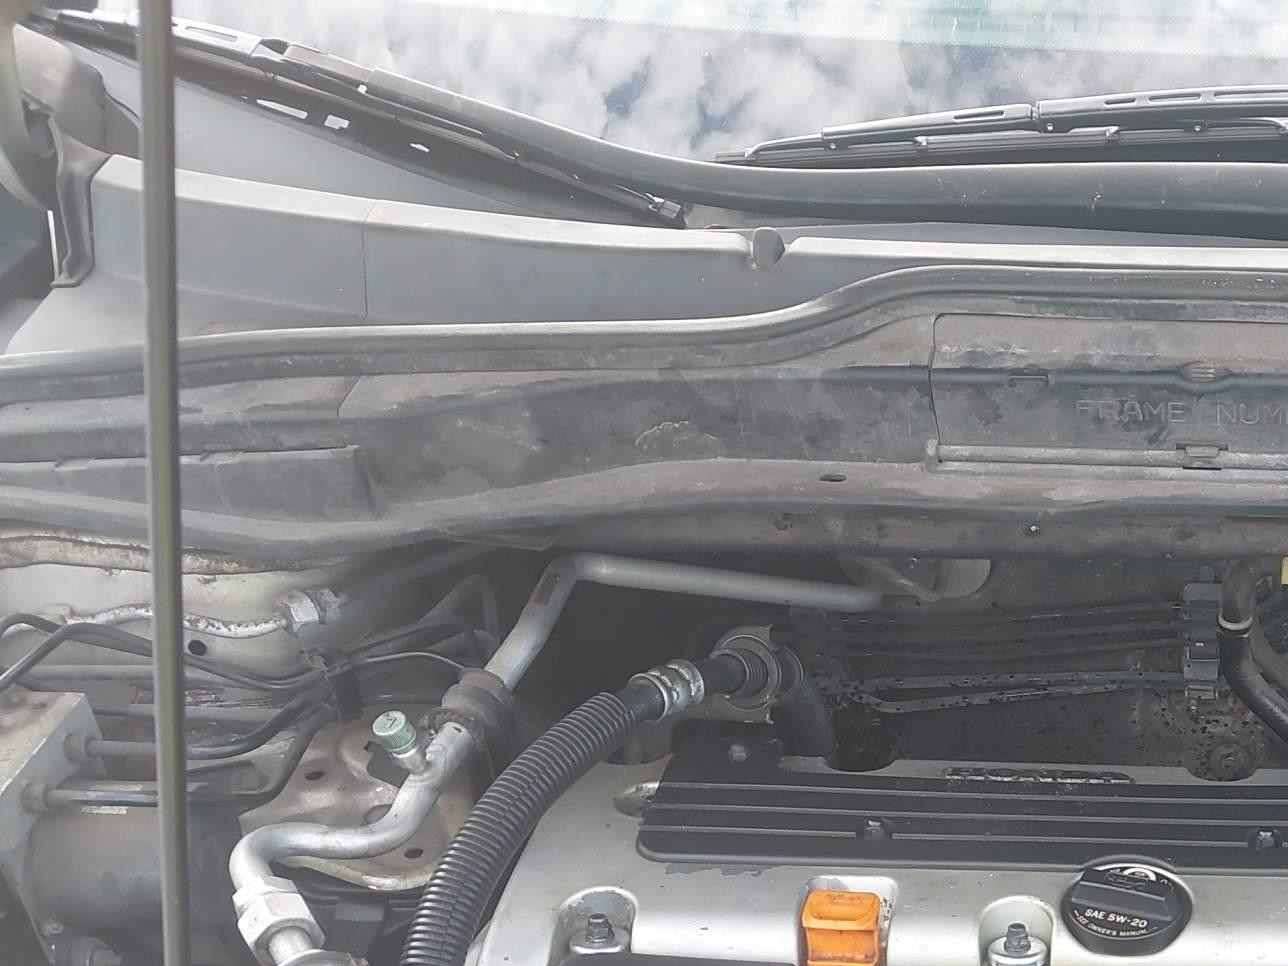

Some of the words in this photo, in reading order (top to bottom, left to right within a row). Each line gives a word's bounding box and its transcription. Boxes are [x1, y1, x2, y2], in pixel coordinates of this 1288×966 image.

[1075, 400, 1187, 423] FRAME
[1084, 908, 1106, 919] SAE
[1107, 912, 1148, 928] 5W-20
